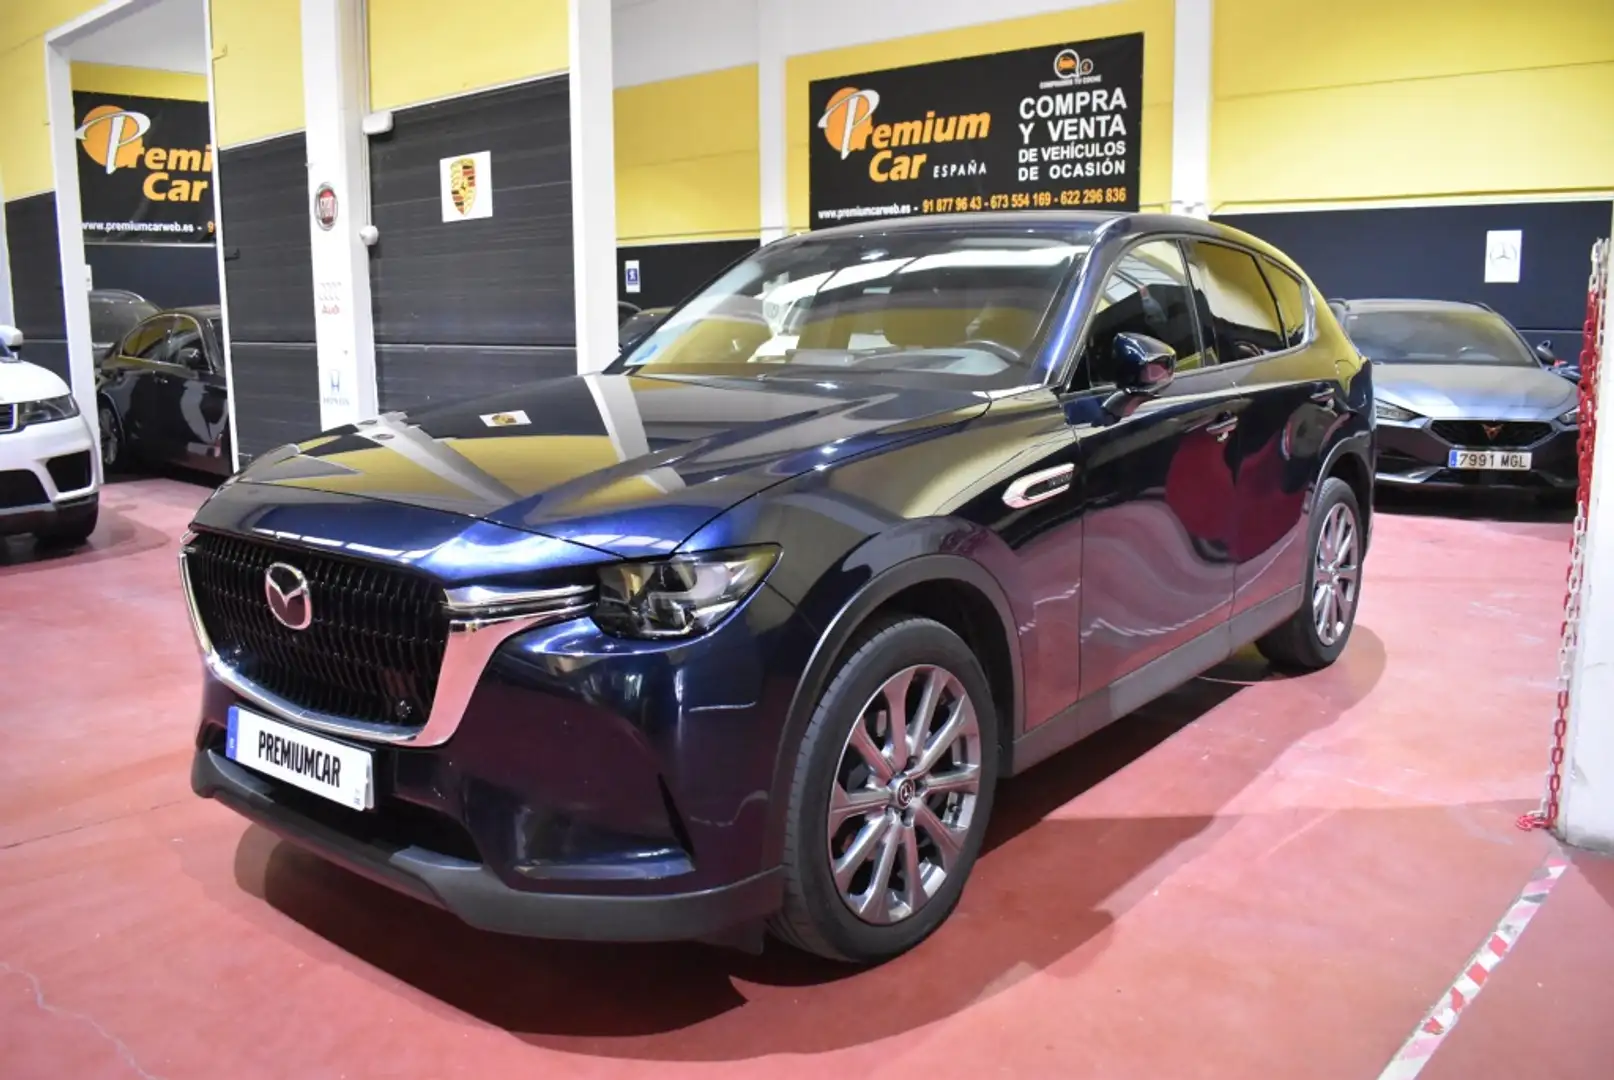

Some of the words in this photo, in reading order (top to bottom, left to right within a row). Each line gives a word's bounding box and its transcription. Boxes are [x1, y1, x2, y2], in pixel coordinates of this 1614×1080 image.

[1019, 87, 1128, 119] COMPRA
[818, 89, 991, 160] Premium
[1018, 122, 1035, 145] Y
[1047, 114, 1127, 142] VENTA
[869, 150, 927, 182] Car
[933, 159, 987, 179] ESPAÑA
[1018, 148, 1038, 163] DE
[1041, 140, 1126, 162] VEHÍCULOS
[1018, 166, 1039, 181] DE
[1049, 157, 1126, 179] OCASIÓN
[143, 172, 208, 202] Car
[818, 203, 911, 220] www.premiumcarweb.es
[922, 199, 933, 213] 91
[936, 198, 953, 212] 877
[956, 197, 968, 211] 96
[970, 196, 982, 210] 43
[990, 194, 1008, 209] 673
[1011, 193, 1029, 208] 554
[1033, 191, 1051, 207] 169
[1061, 190, 1080, 206] 622
[1083, 188, 1103, 204] 296
[1106, 187, 1126, 202] 836
[1460, 453, 1494, 467] 7991
[1500, 454, 1526, 467] MGL
[258, 730, 341, 788] PREMIUMCAR
